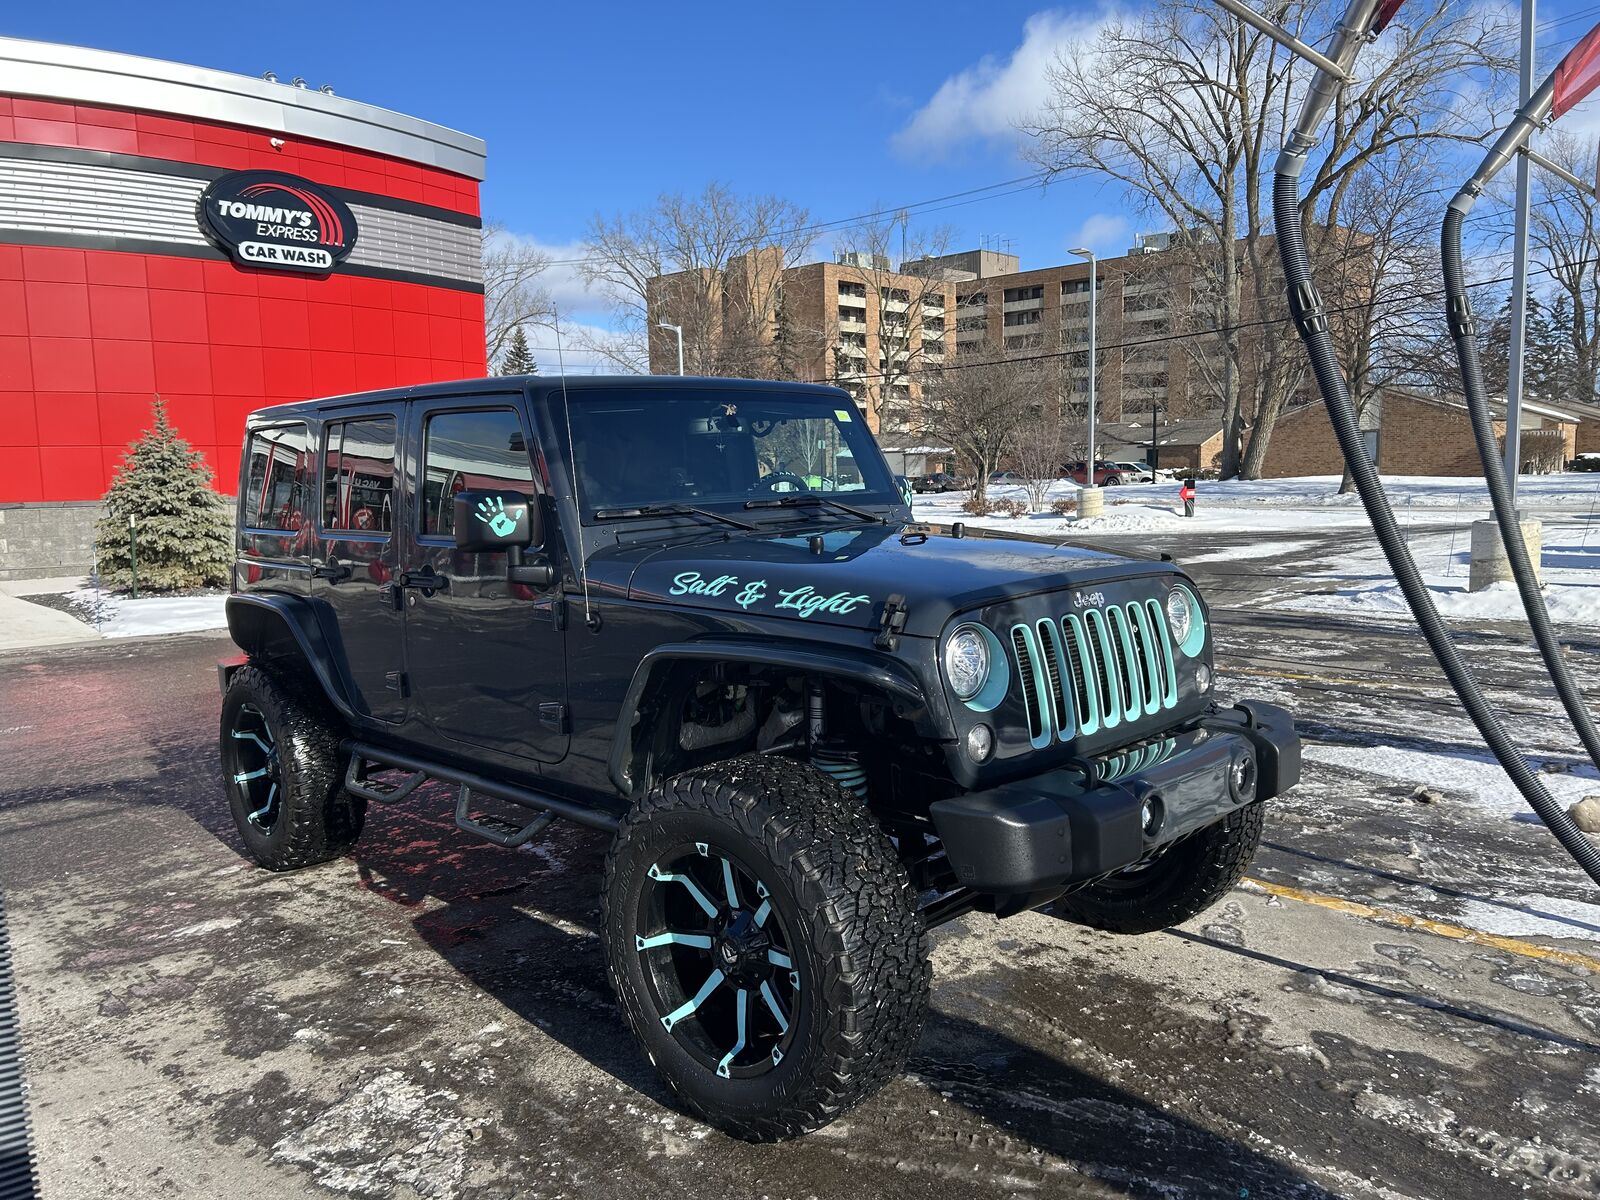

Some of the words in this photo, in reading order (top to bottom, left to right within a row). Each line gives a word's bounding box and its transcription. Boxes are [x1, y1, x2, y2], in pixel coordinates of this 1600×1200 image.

[218, 200, 313, 227] TOMMY'S
[256, 223, 319, 242] EXPRESS
[245, 245, 277, 259] CAR
[281, 248, 327, 265] WASH
[669, 572, 738, 597] Salt
[734, 579, 768, 610] &
[774, 585, 870, 618] Light
[1073, 591, 1105, 608] Jeep
